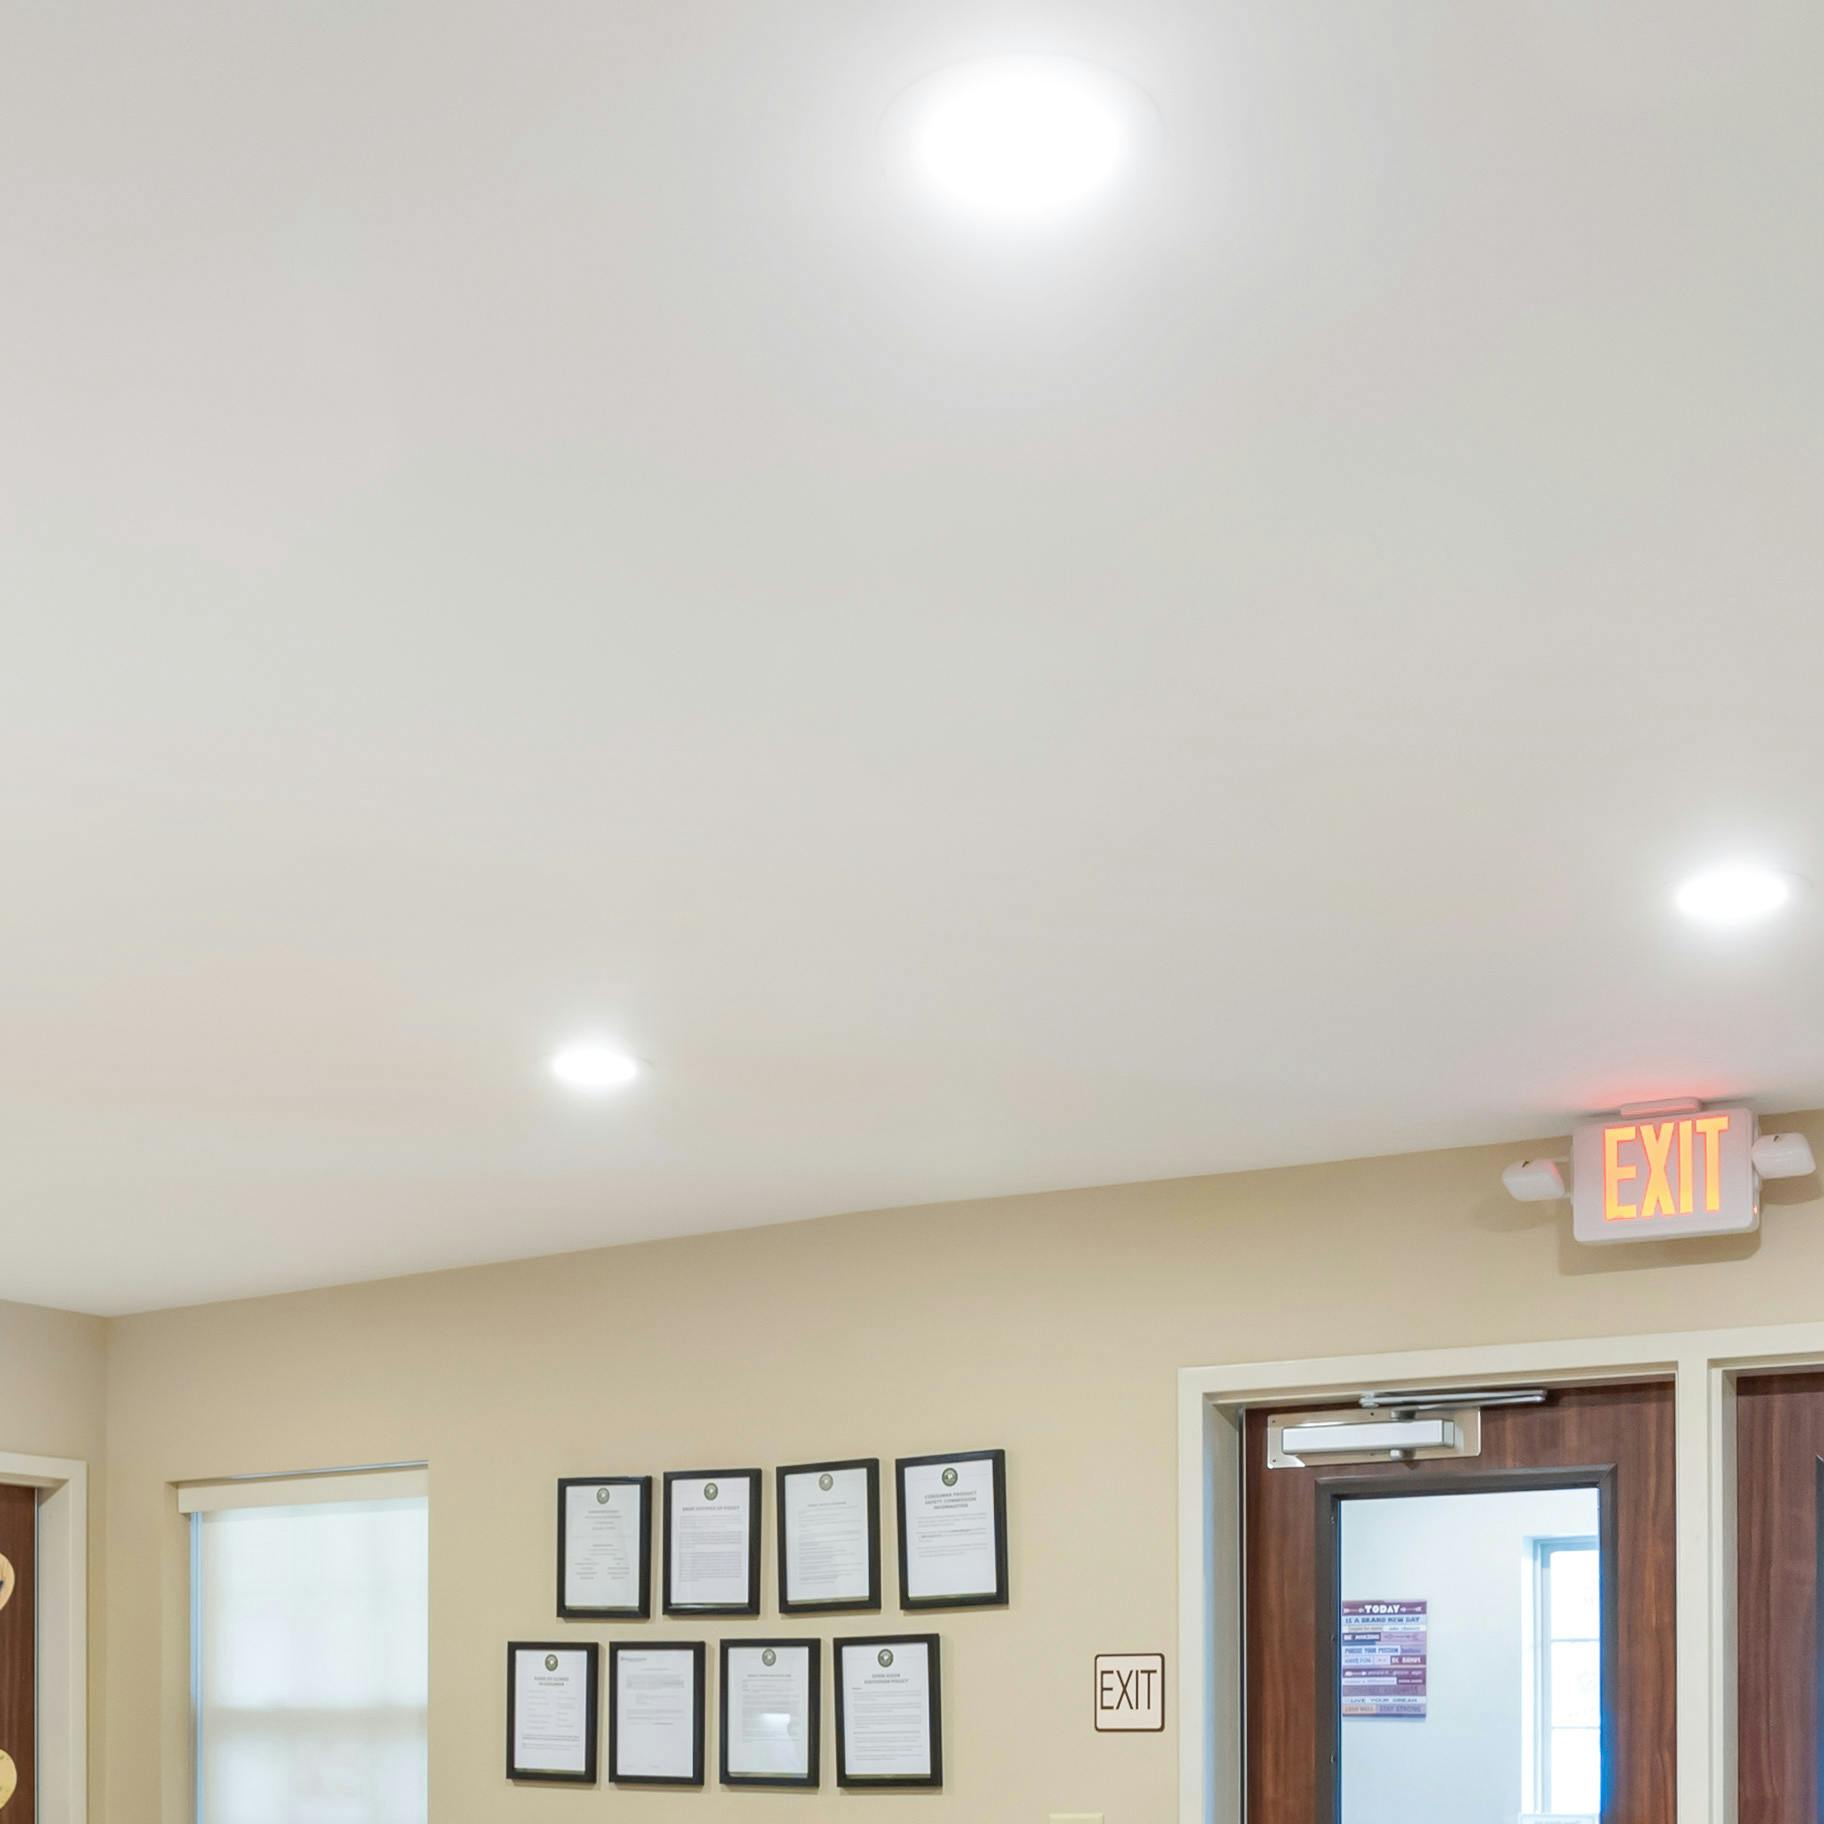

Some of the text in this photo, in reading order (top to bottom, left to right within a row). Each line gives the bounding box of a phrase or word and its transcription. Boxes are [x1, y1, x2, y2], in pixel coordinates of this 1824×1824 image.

[1603, 1115, 1729, 1222] EXIT
[1364, 1604, 1401, 1614] TODAY
[1100, 1669, 1158, 1710] EXIT
